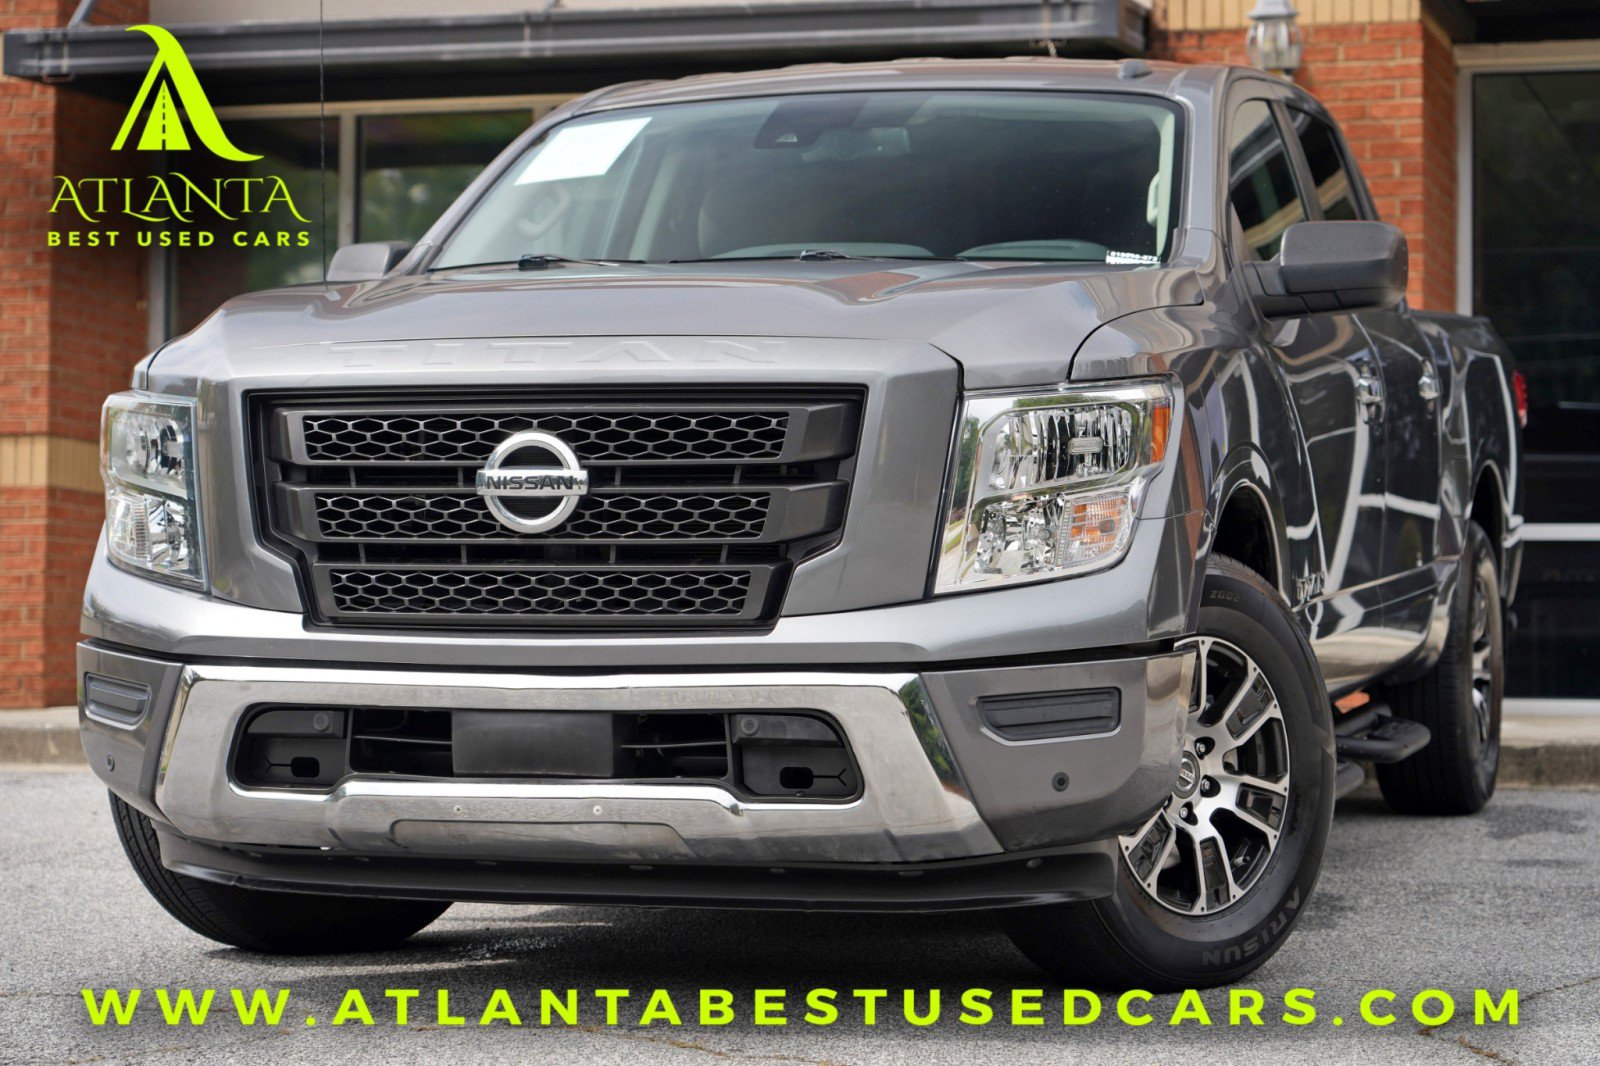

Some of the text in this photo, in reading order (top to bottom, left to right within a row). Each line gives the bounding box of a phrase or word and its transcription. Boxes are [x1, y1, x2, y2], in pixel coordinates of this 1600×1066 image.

[331, 341, 788, 367] TITAN
[486, 475, 574, 490] NISSAN
[1200, 886, 1300, 967] ARISUN
